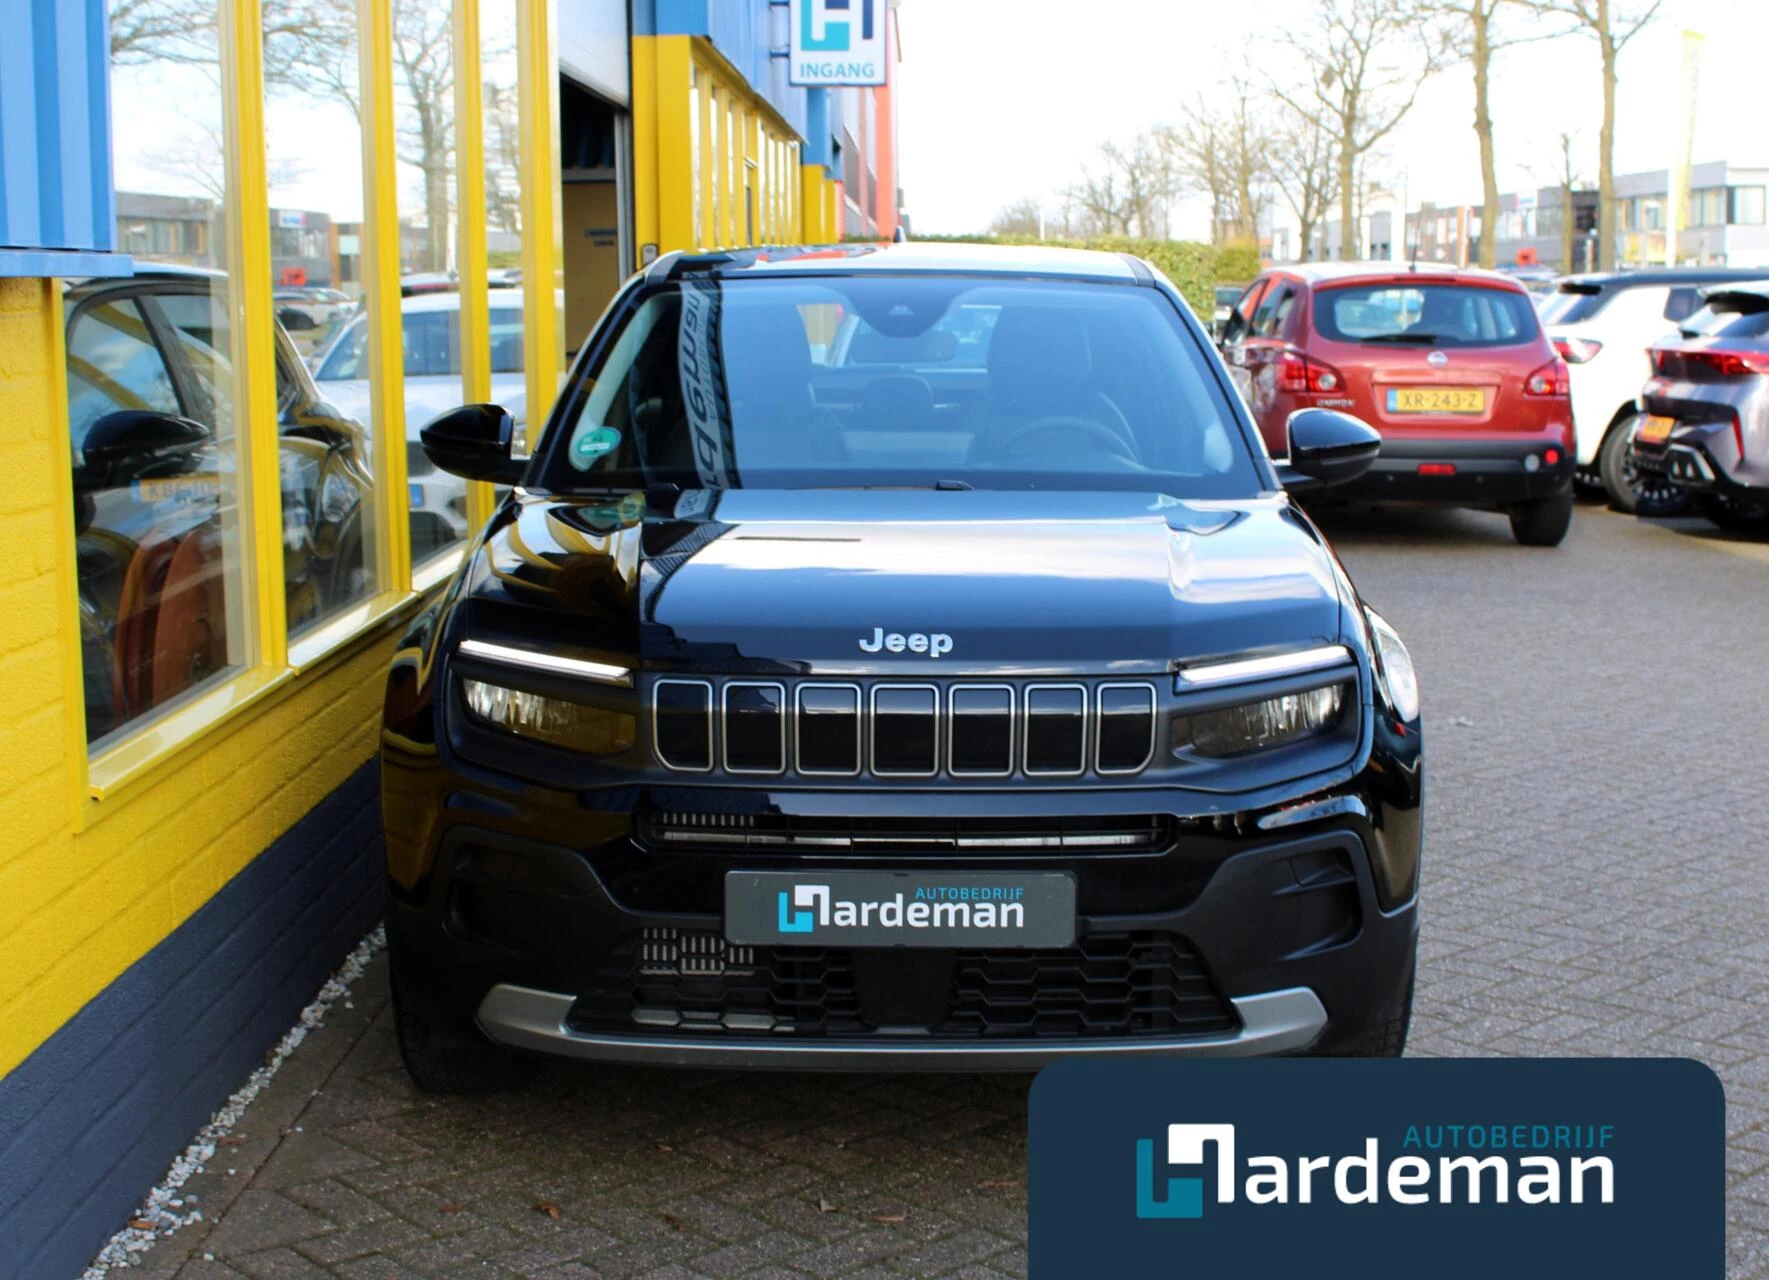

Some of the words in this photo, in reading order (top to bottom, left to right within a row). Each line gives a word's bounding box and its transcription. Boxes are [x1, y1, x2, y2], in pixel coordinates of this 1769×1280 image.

[800, 62, 875, 78] INGANG
[1403, 393, 1478, 407] XR-243-Z
[859, 627, 953, 658] Jeep
[915, 887, 1024, 900] AUTOBEDRIJF
